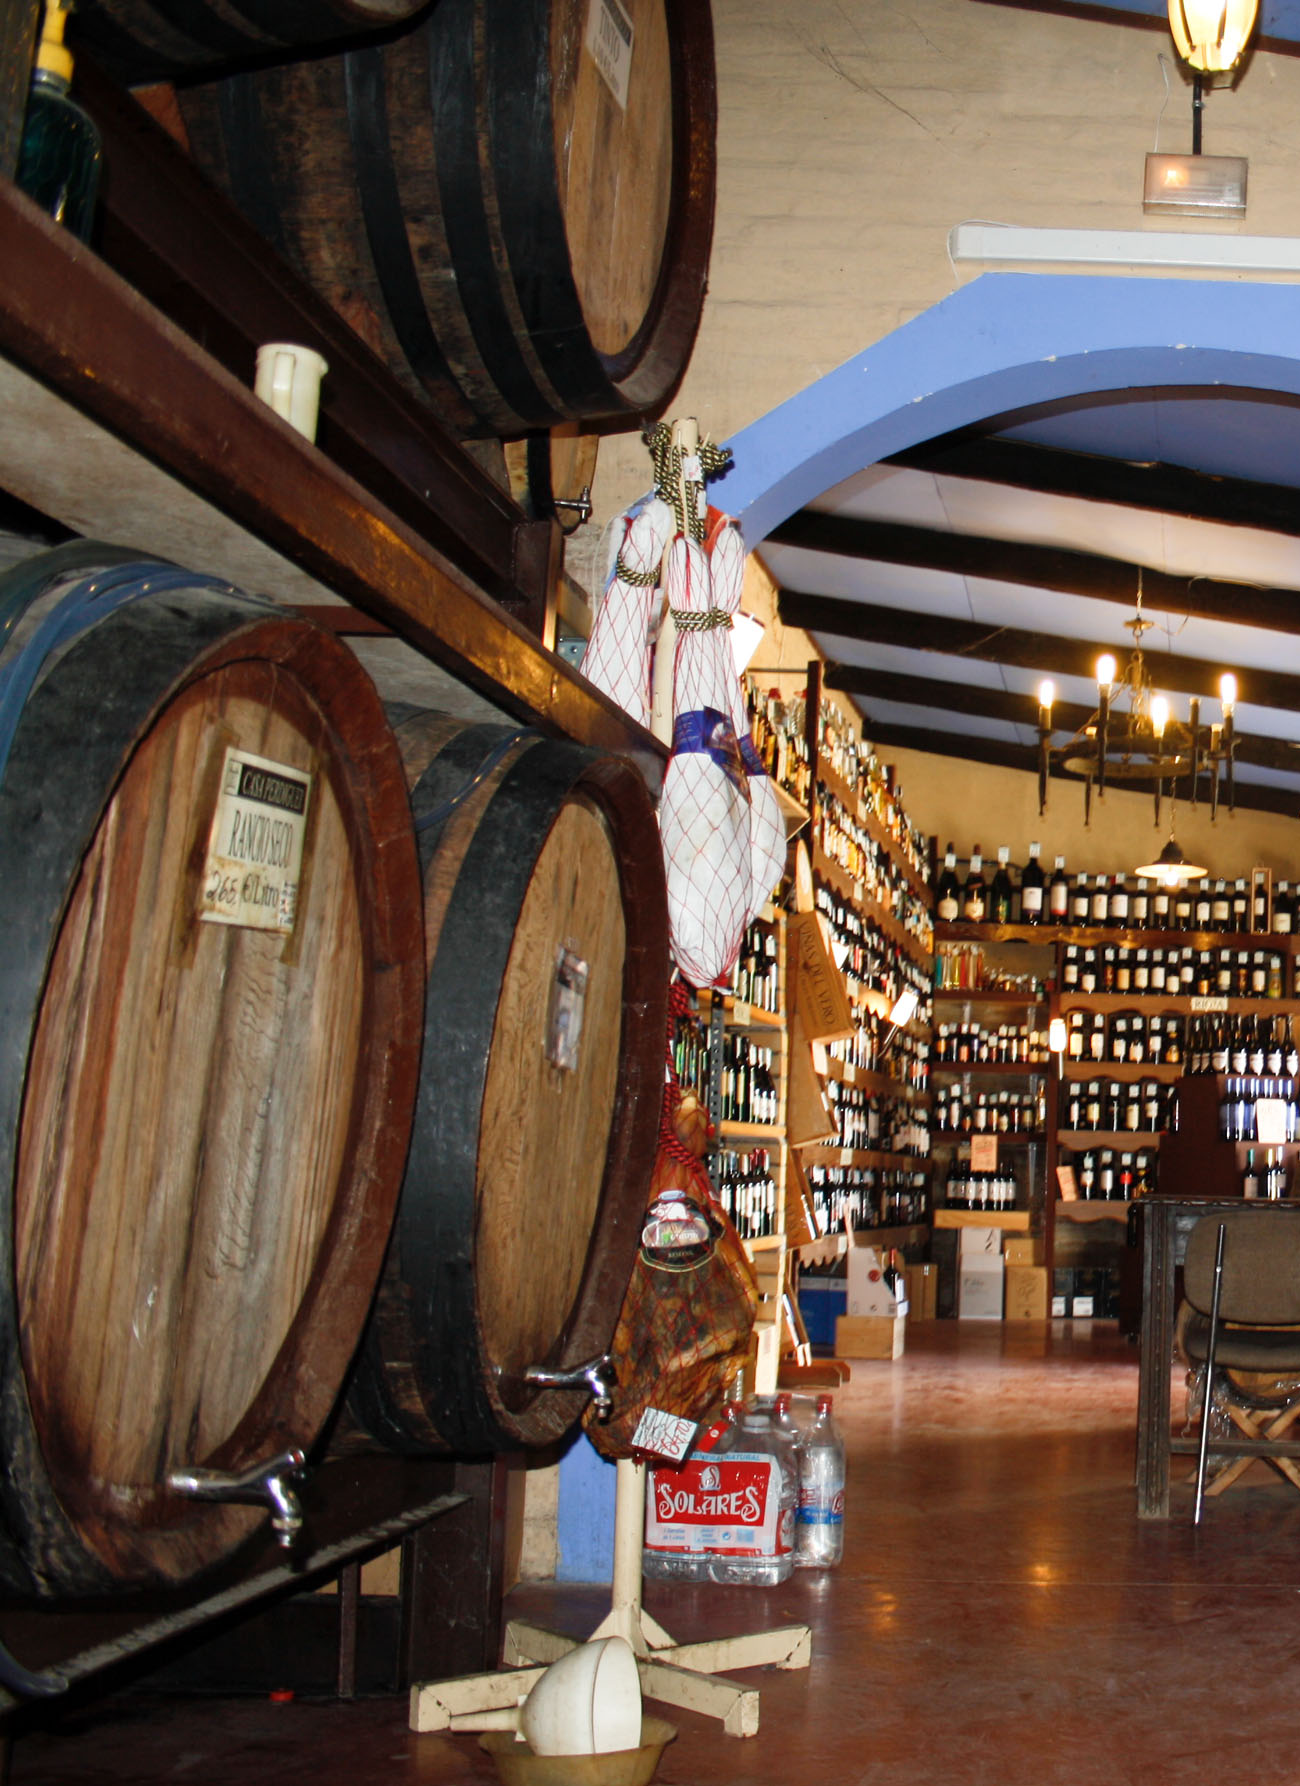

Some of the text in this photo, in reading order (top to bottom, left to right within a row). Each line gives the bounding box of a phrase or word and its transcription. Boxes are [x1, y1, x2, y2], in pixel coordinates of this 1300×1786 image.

[243, 770, 265, 798] CASA
[228, 809, 293, 869] RANCIO SECO
[725, 1453, 760, 1462] NATURAL
[658, 1482, 761, 1523] SOLARES
